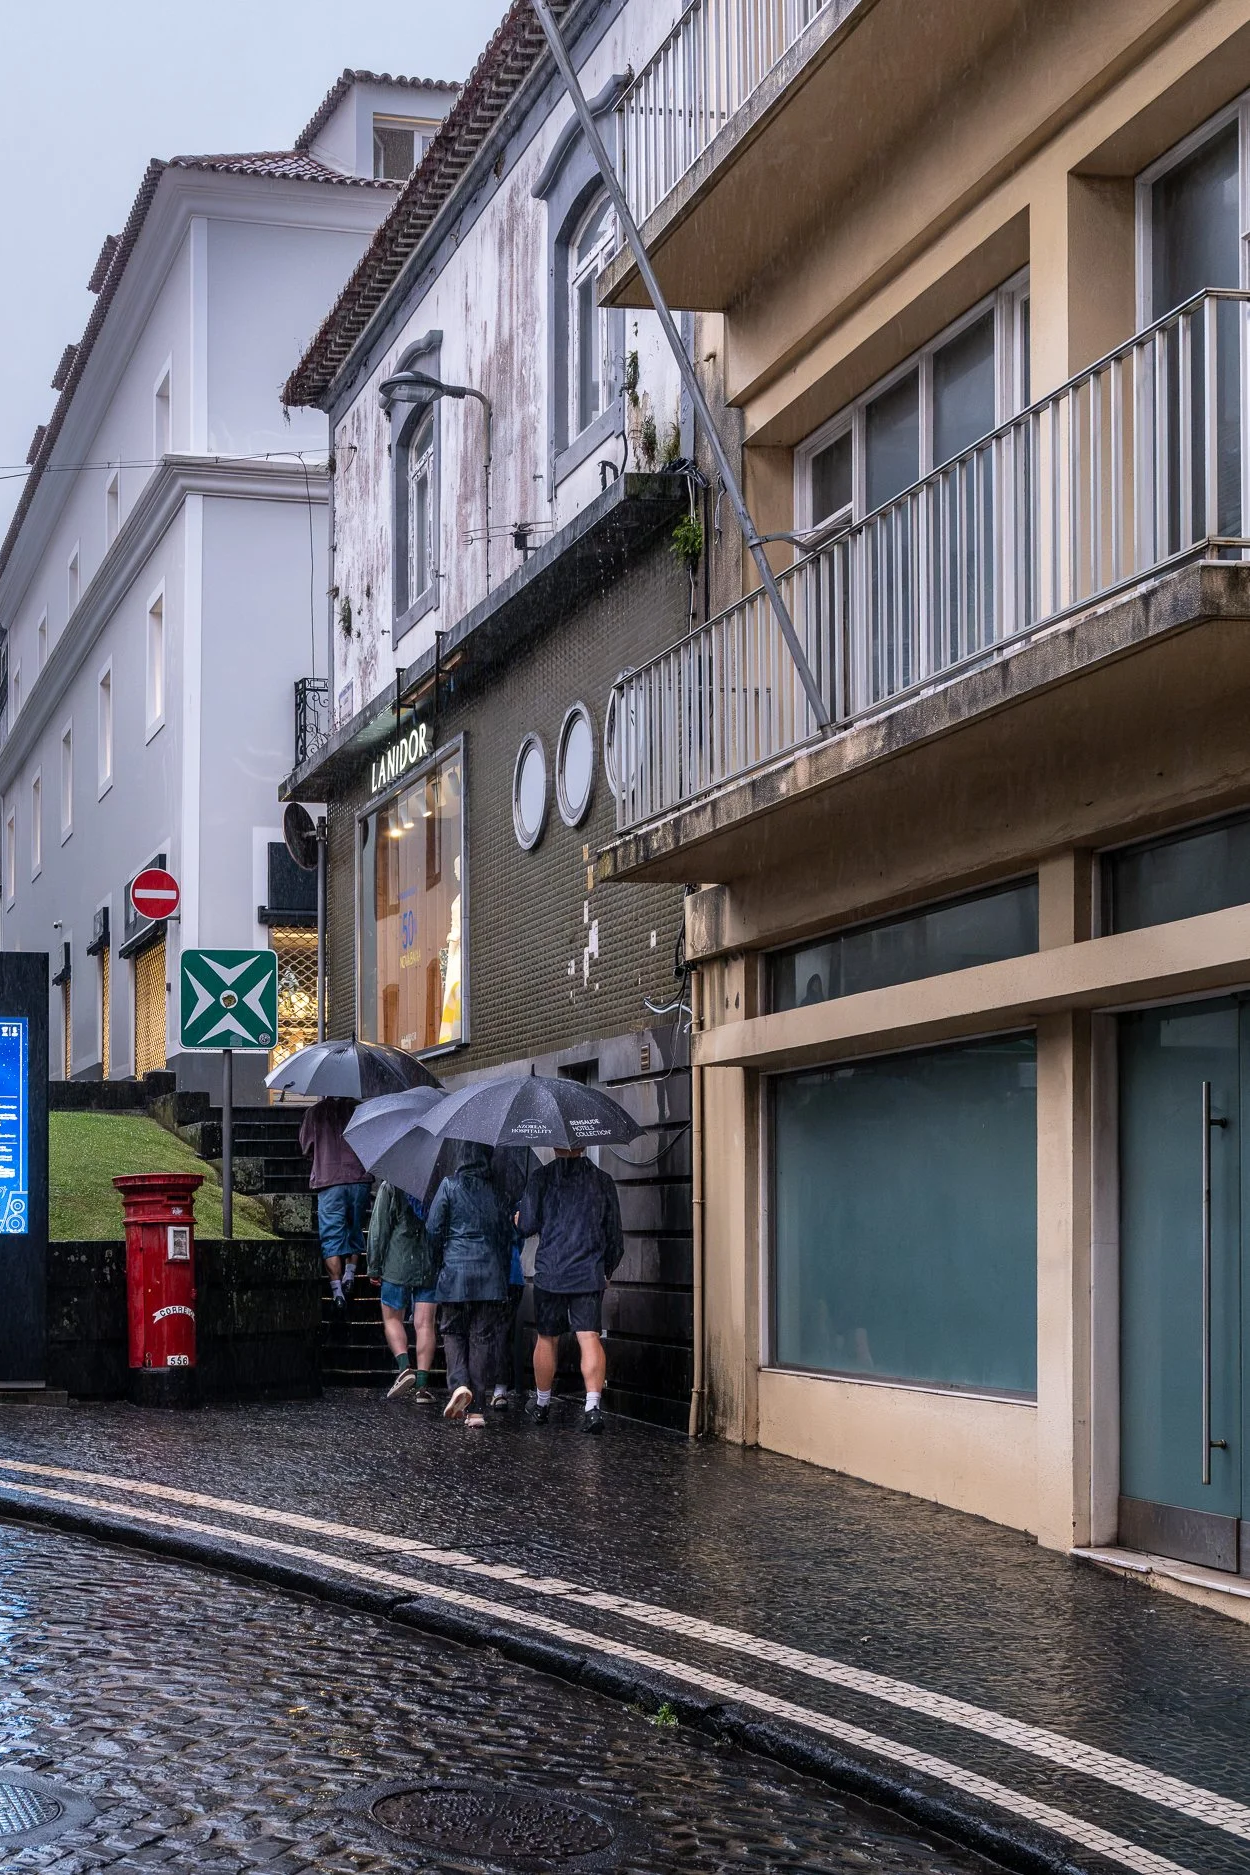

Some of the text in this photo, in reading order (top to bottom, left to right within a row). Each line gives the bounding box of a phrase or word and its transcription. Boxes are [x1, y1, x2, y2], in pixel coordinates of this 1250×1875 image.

[372, 722, 427, 794] LANIDOR
[569, 1118, 600, 1126] BENSAUDE
[159, 1306, 194, 1317] CORREIO
[170, 1356, 188, 1366] 556
